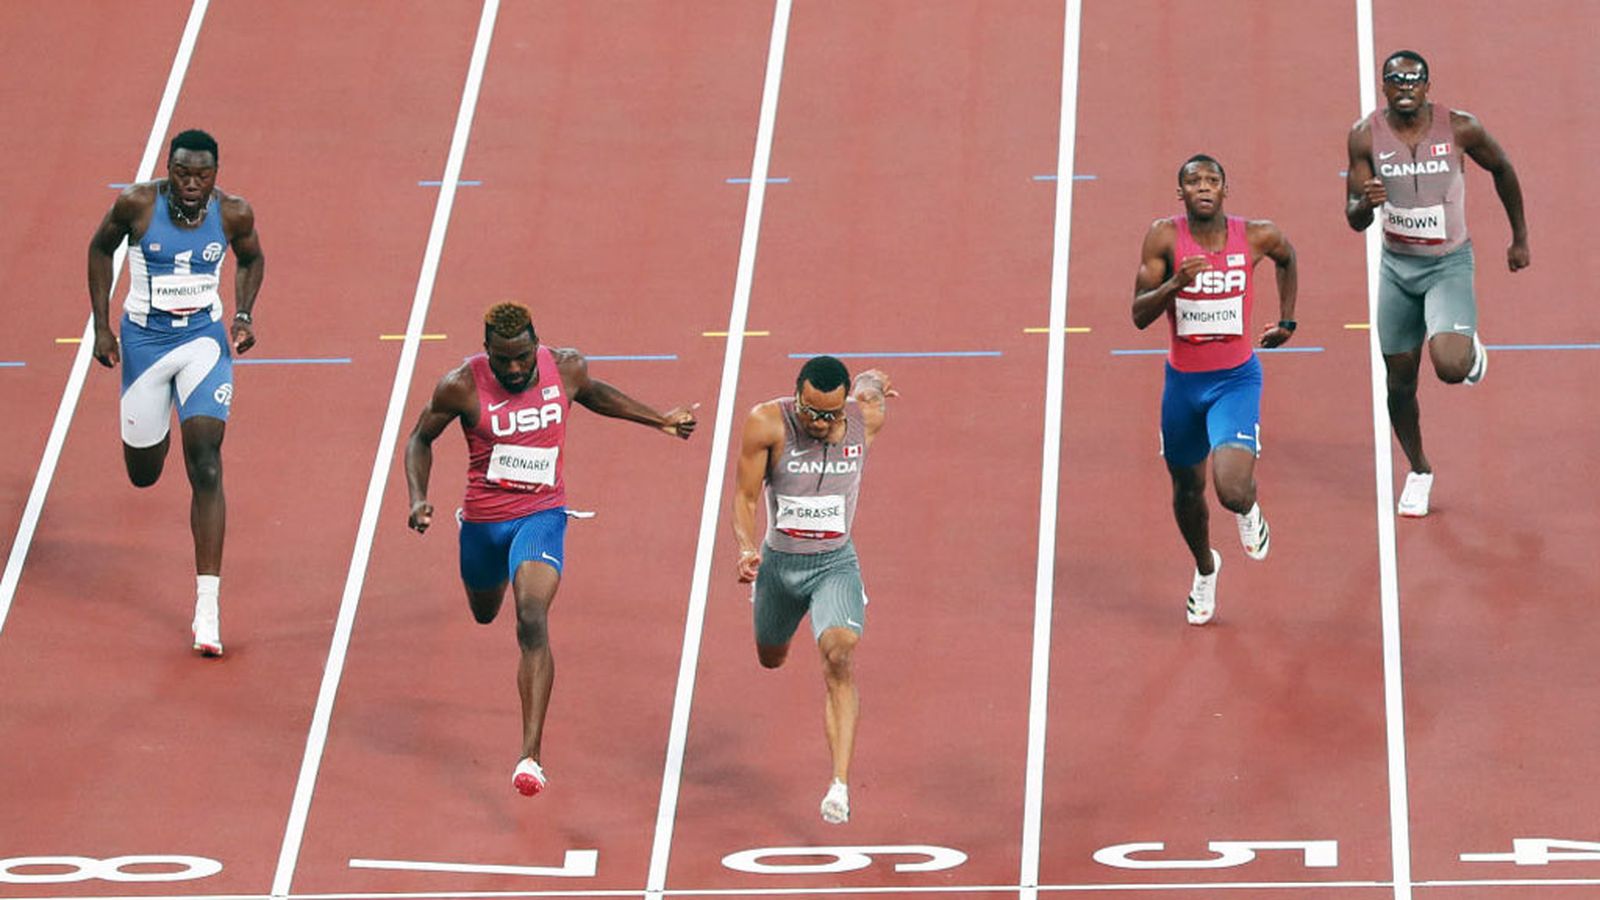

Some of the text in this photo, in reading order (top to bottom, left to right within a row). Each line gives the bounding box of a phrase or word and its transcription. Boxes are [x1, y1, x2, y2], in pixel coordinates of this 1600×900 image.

[1380, 160, 1450, 177] CANADA
[1388, 212, 1438, 229] BROWN
[1181, 308, 1237, 323] KNIGHTON
[490, 402, 562, 436] USA
[787, 461, 857, 474] CANADA
[797, 505, 840, 519] GRASSE
[349, 849, 598, 877] 7
[721, 845, 968, 874] 6
[1093, 840, 1338, 868] 5
[0, 855, 223, 884] 8
